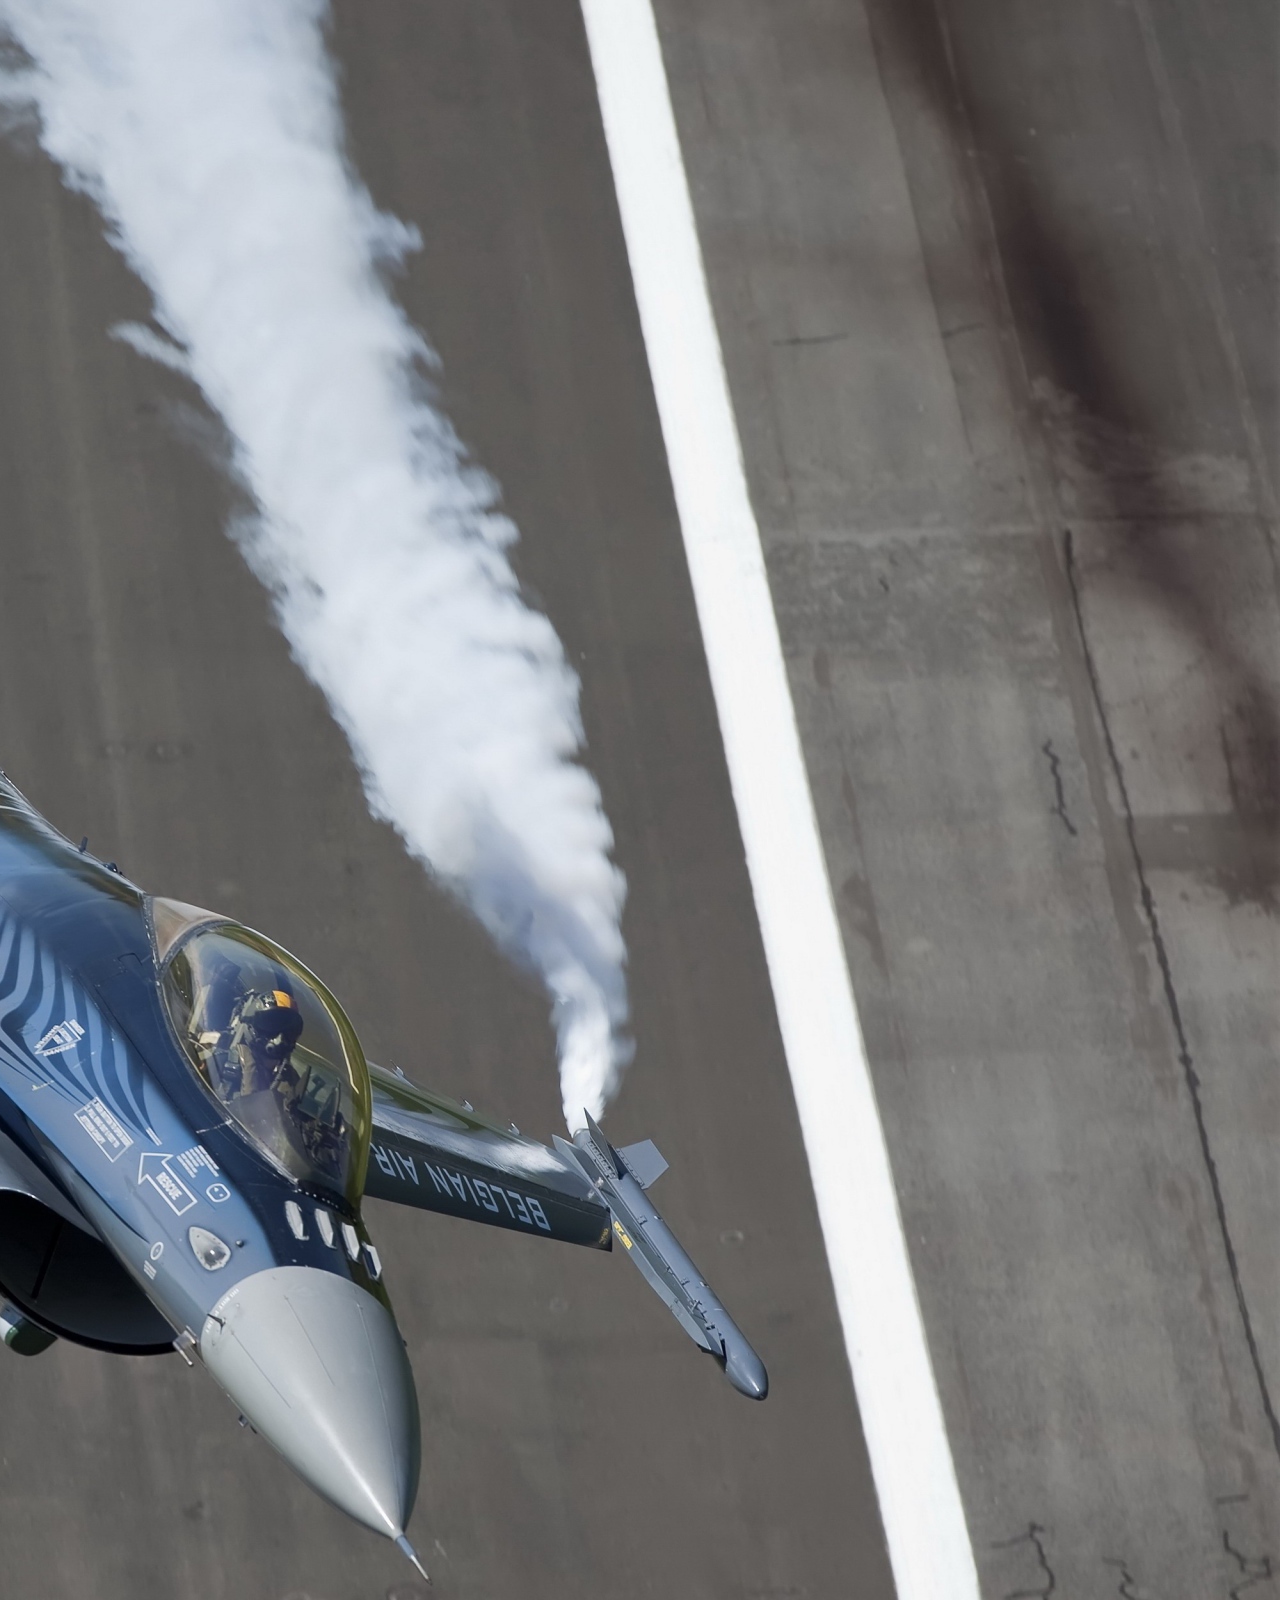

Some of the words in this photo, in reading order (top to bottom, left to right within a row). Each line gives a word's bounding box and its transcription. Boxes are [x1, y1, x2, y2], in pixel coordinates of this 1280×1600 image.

[155, 1171, 185, 1201] RESCUE
[370, 1142, 420, 1186] AIR
[424, 1161, 552, 1232] BELGIAN
